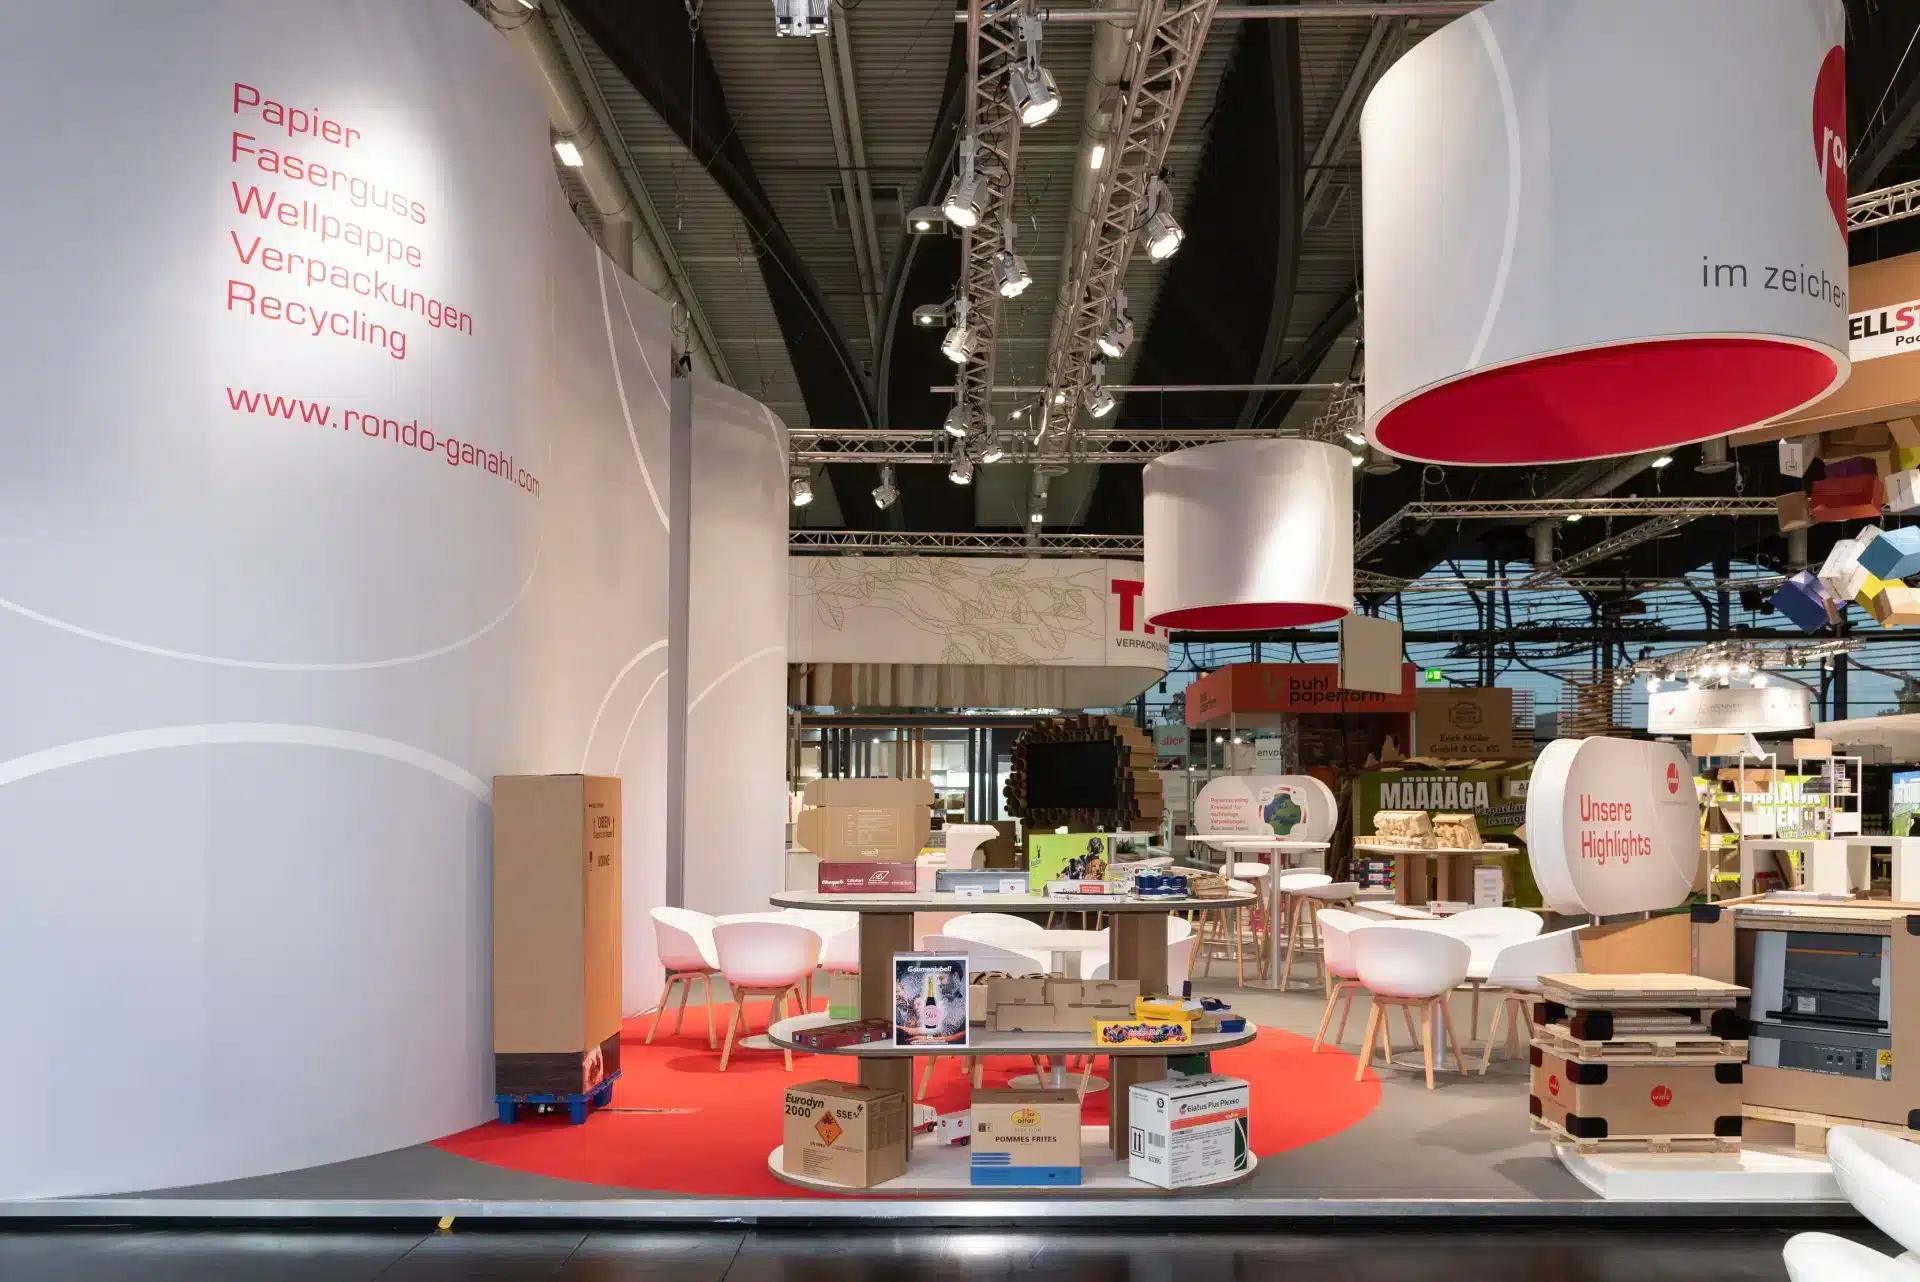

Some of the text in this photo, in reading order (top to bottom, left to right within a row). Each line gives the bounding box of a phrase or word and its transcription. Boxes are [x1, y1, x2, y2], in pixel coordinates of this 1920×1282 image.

[233, 82, 360, 148] Papier
[232, 131, 426, 225] Faserguss
[231, 181, 421, 268] Wellpappe
[230, 230, 473, 336] Verpackungen
[1702, 256, 1847, 315] im zeichen
[227, 279, 407, 360] Recycling
[226, 387, 540, 499] www.rondo-ganahl.com
[1289, 676, 1329, 691] buhl
[1580, 794, 1632, 822] Unsere
[1581, 830, 1652, 866] Highlights
[785, 1093, 825, 1110] Eurodyn
[785, 1104, 811, 1118] 2000
[836, 1109, 853, 1120] SSE
[1186, 1098, 1240, 1113] Elatus Plus Plexeo
